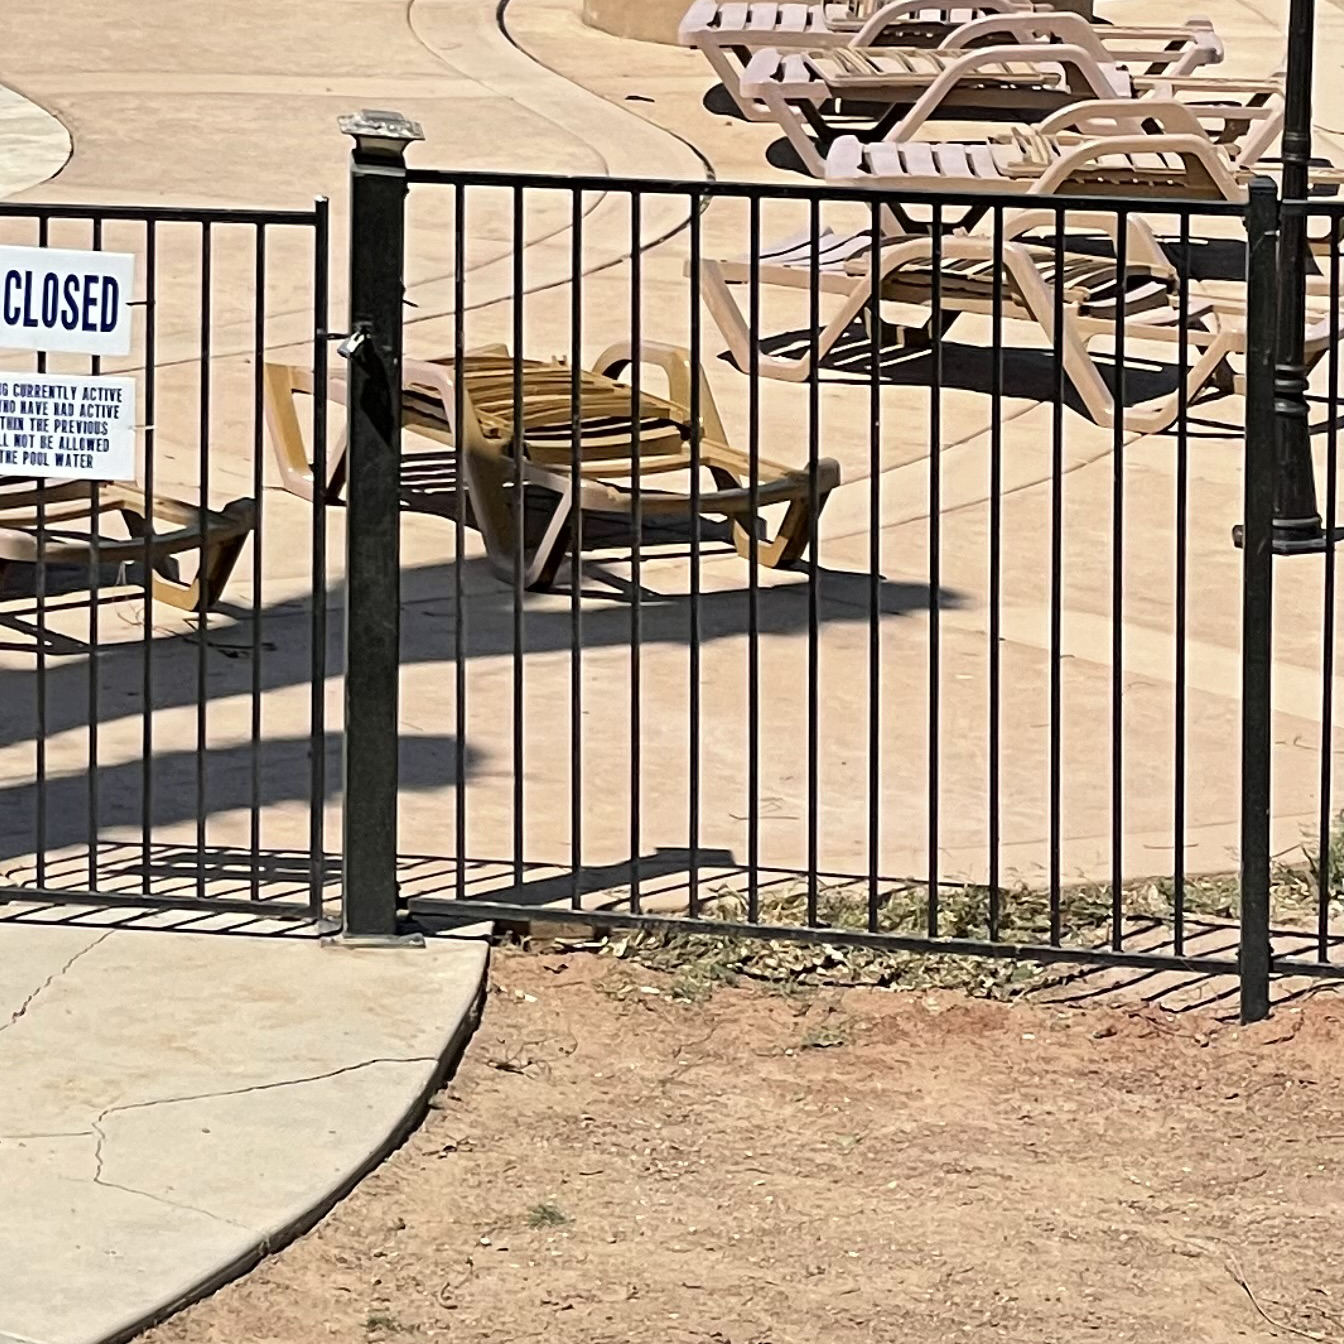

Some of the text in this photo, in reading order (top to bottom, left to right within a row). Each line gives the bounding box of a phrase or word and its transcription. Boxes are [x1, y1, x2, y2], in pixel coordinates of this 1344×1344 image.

[4, 270, 119, 332] CLOSED
[12, 383, 76, 400] CURRENTLY
[81, 386, 122, 403] ACTIVE
[19, 400, 48, 415] HAVE
[53, 401, 74, 416] HAD
[79, 403, 119, 419] ACTIVE
[29, 417, 49, 432] THE
[53, 418, 108, 435] PREVIOUS
[13, 433, 34, 448] NOT
[39, 434, 53, 449] BE
[58, 435, 109, 452] ALLOWED
[22, 450, 49, 466] POOL
[54, 452, 93, 468] WATER
